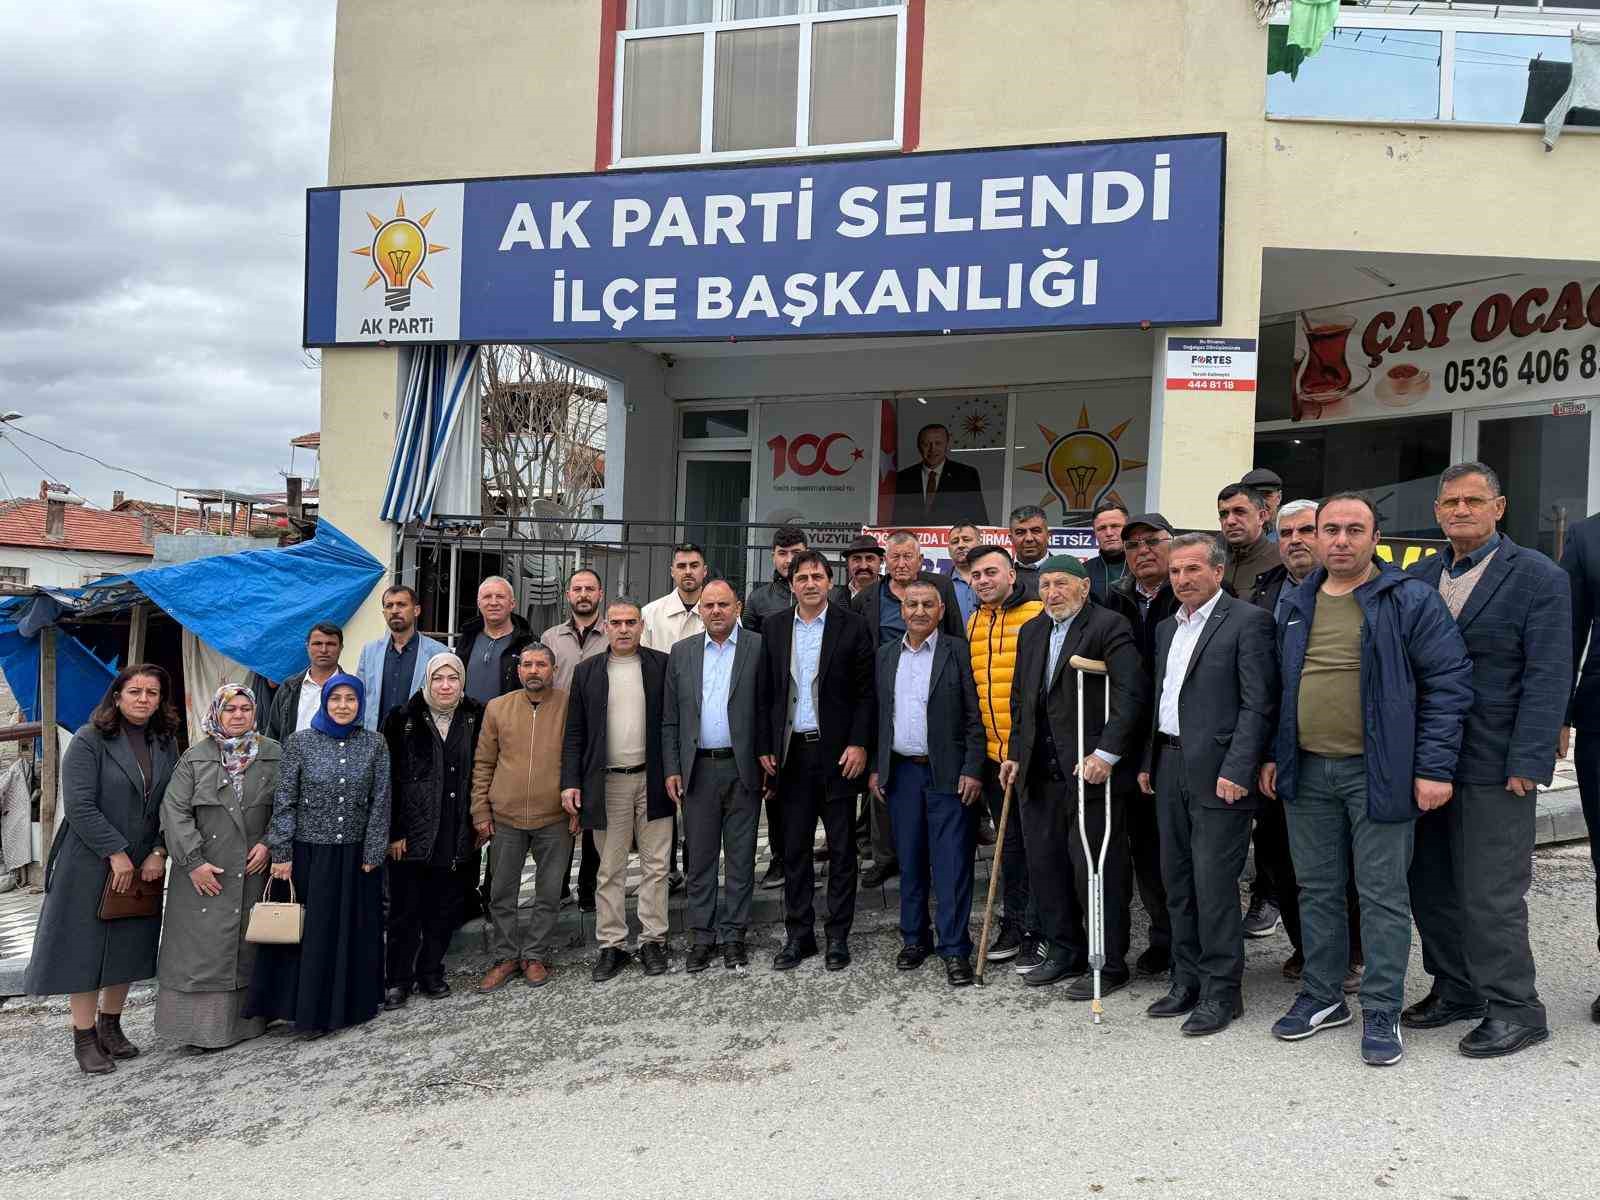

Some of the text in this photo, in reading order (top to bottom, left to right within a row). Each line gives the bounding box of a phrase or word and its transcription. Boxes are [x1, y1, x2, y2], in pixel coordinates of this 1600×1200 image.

[498, 153, 1171, 251] AK PARTİ SELENDİ
[553, 247, 1098, 331] İLÇE BAŞKANLIĞI
[359, 318, 383, 335] AK
[1361, 281, 1600, 368] ÇAY OCA
[1187, 380, 1208, 390] 444
[1191, 355, 1232, 365] FORTES
[1444, 344, 1600, 394] 0536 406 8
